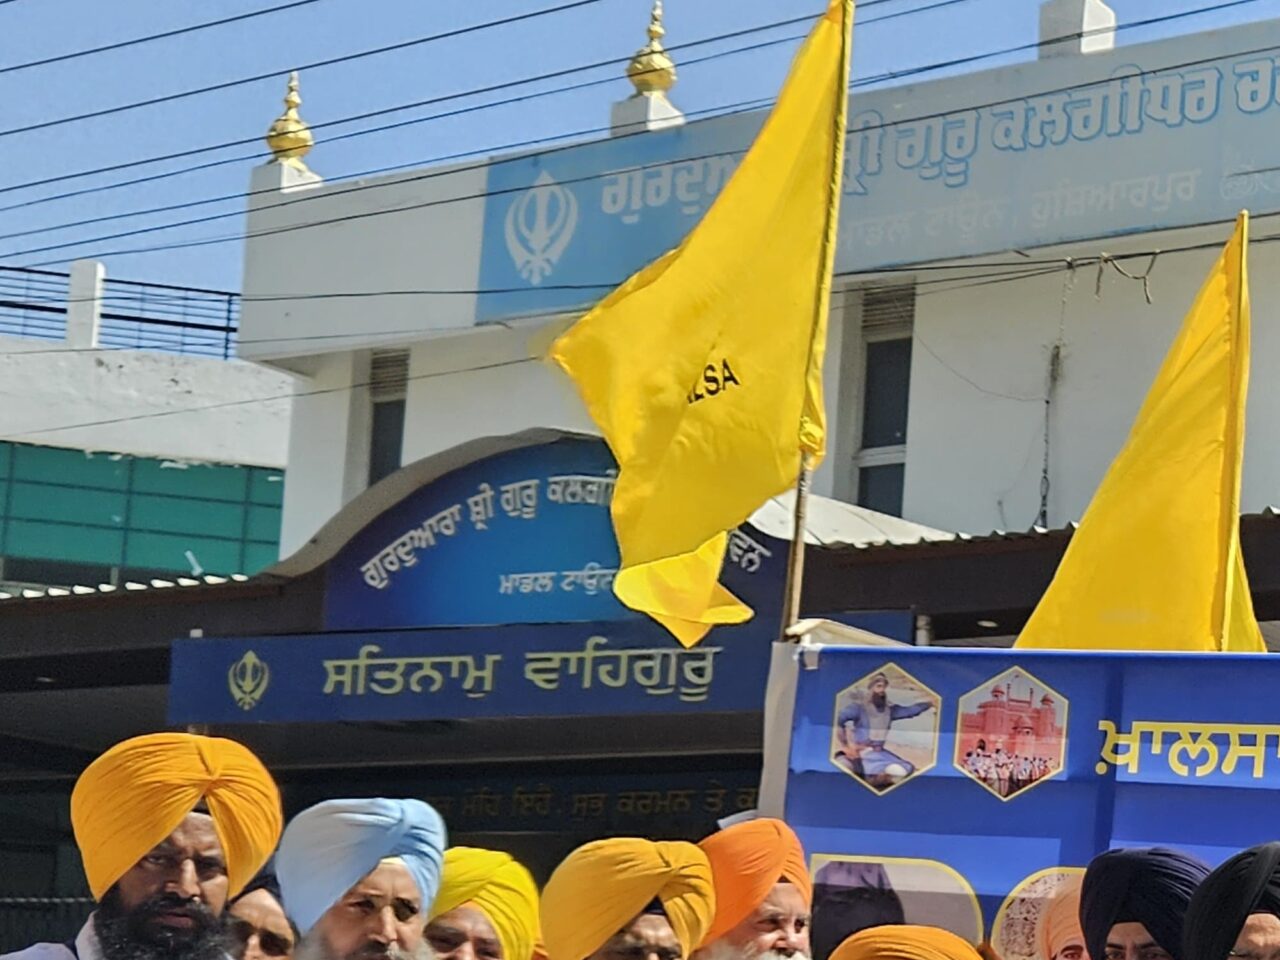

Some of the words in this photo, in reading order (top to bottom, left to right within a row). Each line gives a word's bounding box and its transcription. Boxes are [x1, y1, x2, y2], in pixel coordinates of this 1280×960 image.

[896, 108, 981, 187] ਗੁਰੂ
[990, 64, 1222, 151] ਕਲਗੀਧਰ
[361, 504, 462, 589] ਗੁਰਦੁਆਰਾ
[501, 481, 541, 519] ਗੁਰੂ
[500, 571, 557, 595] ਮਾਡਲ
[322, 645, 503, 699] ਸਤਿਨਾਮੁ
[525, 637, 723, 702] ਵਾਹਿਗੁਰੂ
